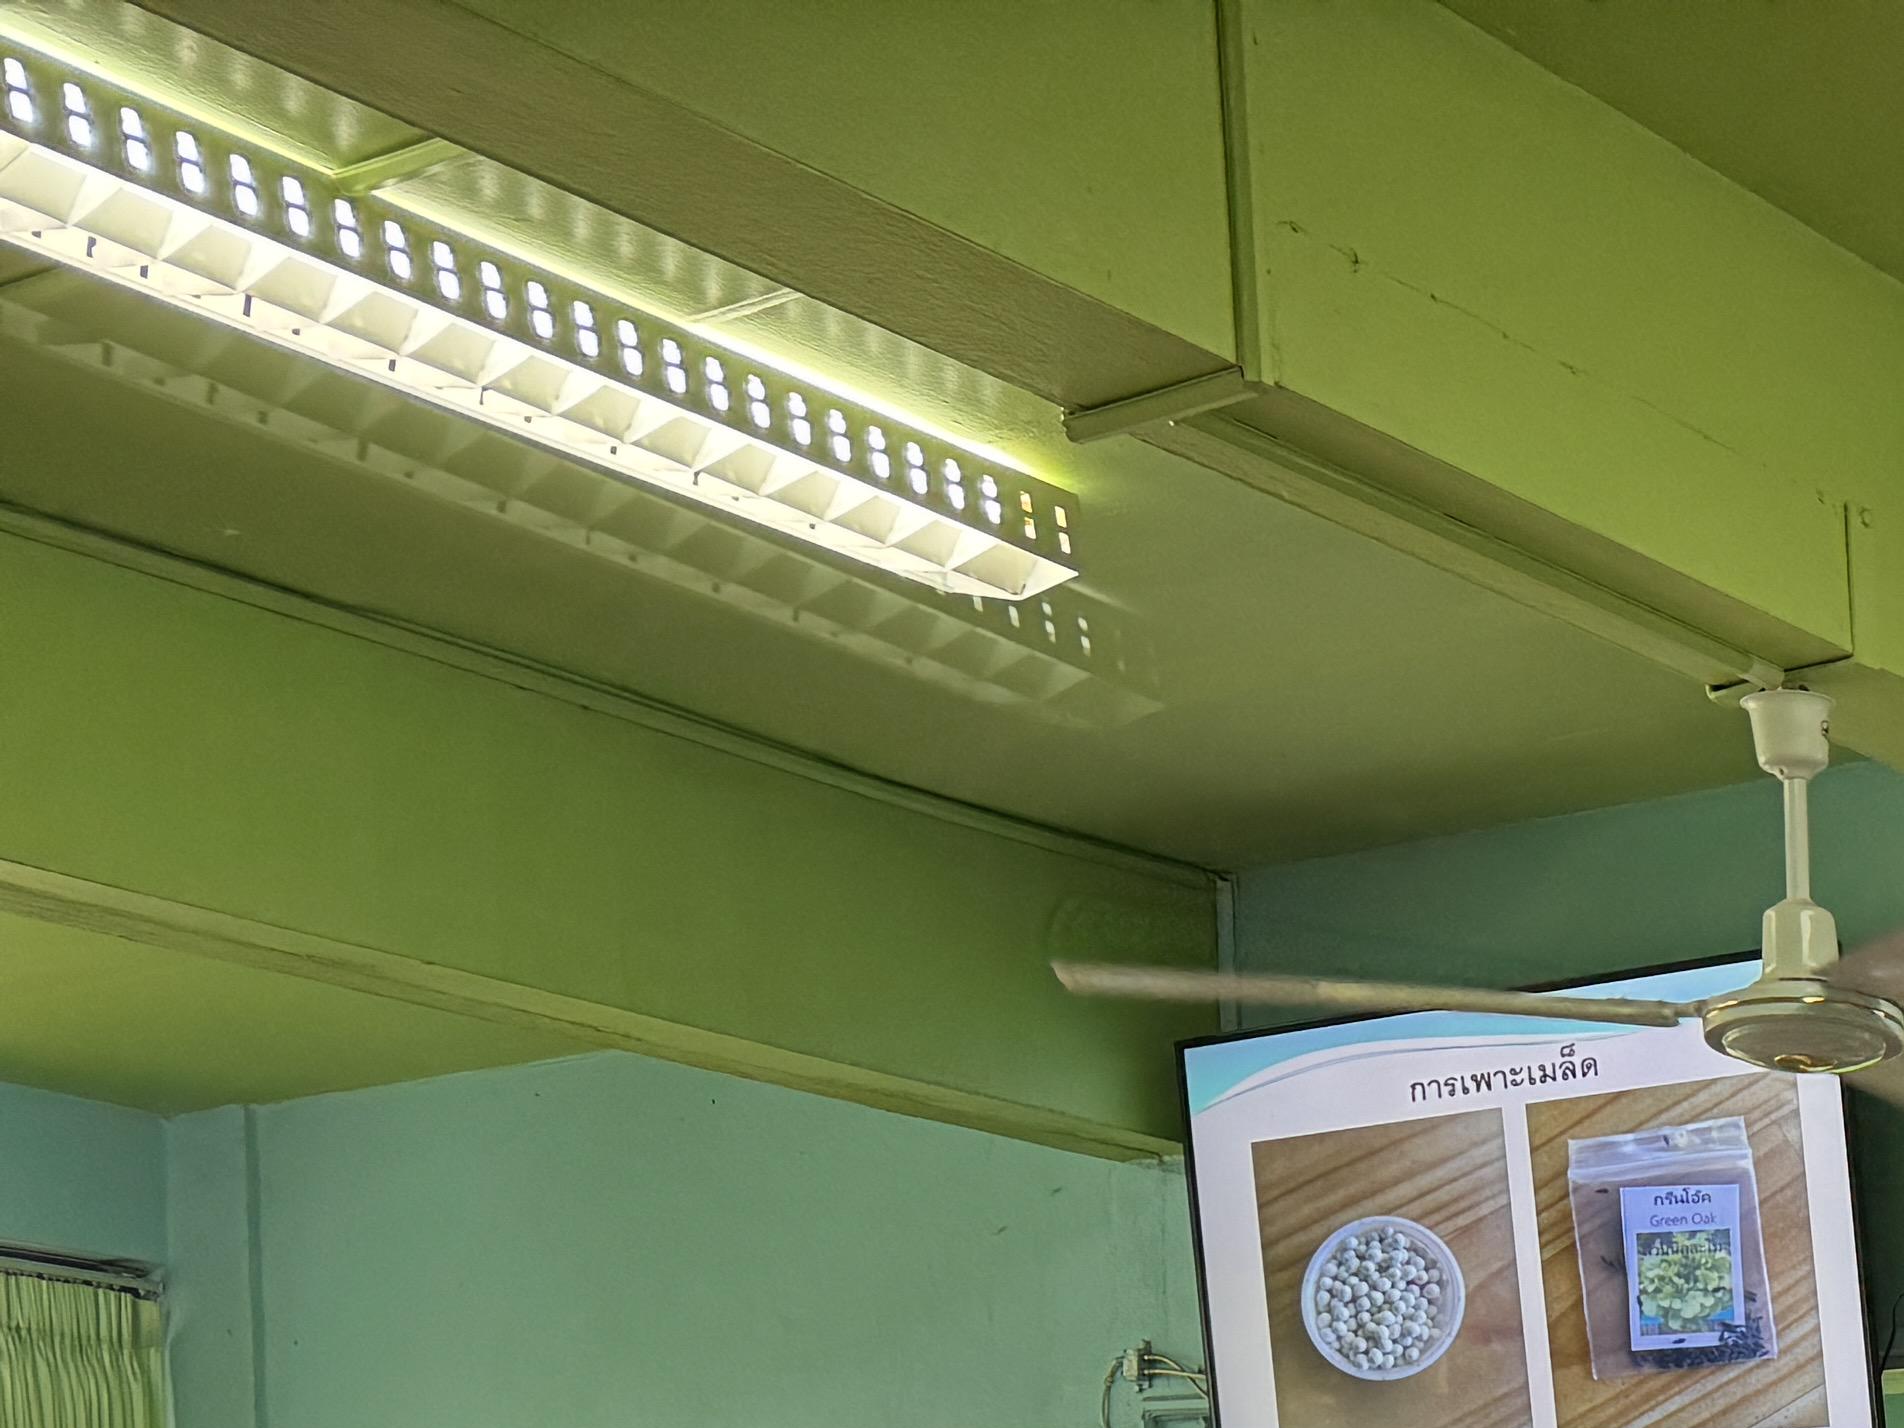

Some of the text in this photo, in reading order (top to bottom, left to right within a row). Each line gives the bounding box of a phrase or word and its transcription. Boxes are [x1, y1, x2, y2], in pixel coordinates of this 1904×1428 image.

[1409, 1043, 1599, 1102] การเพาะเมล็ด
[1649, 1213, 1688, 1227] Green
